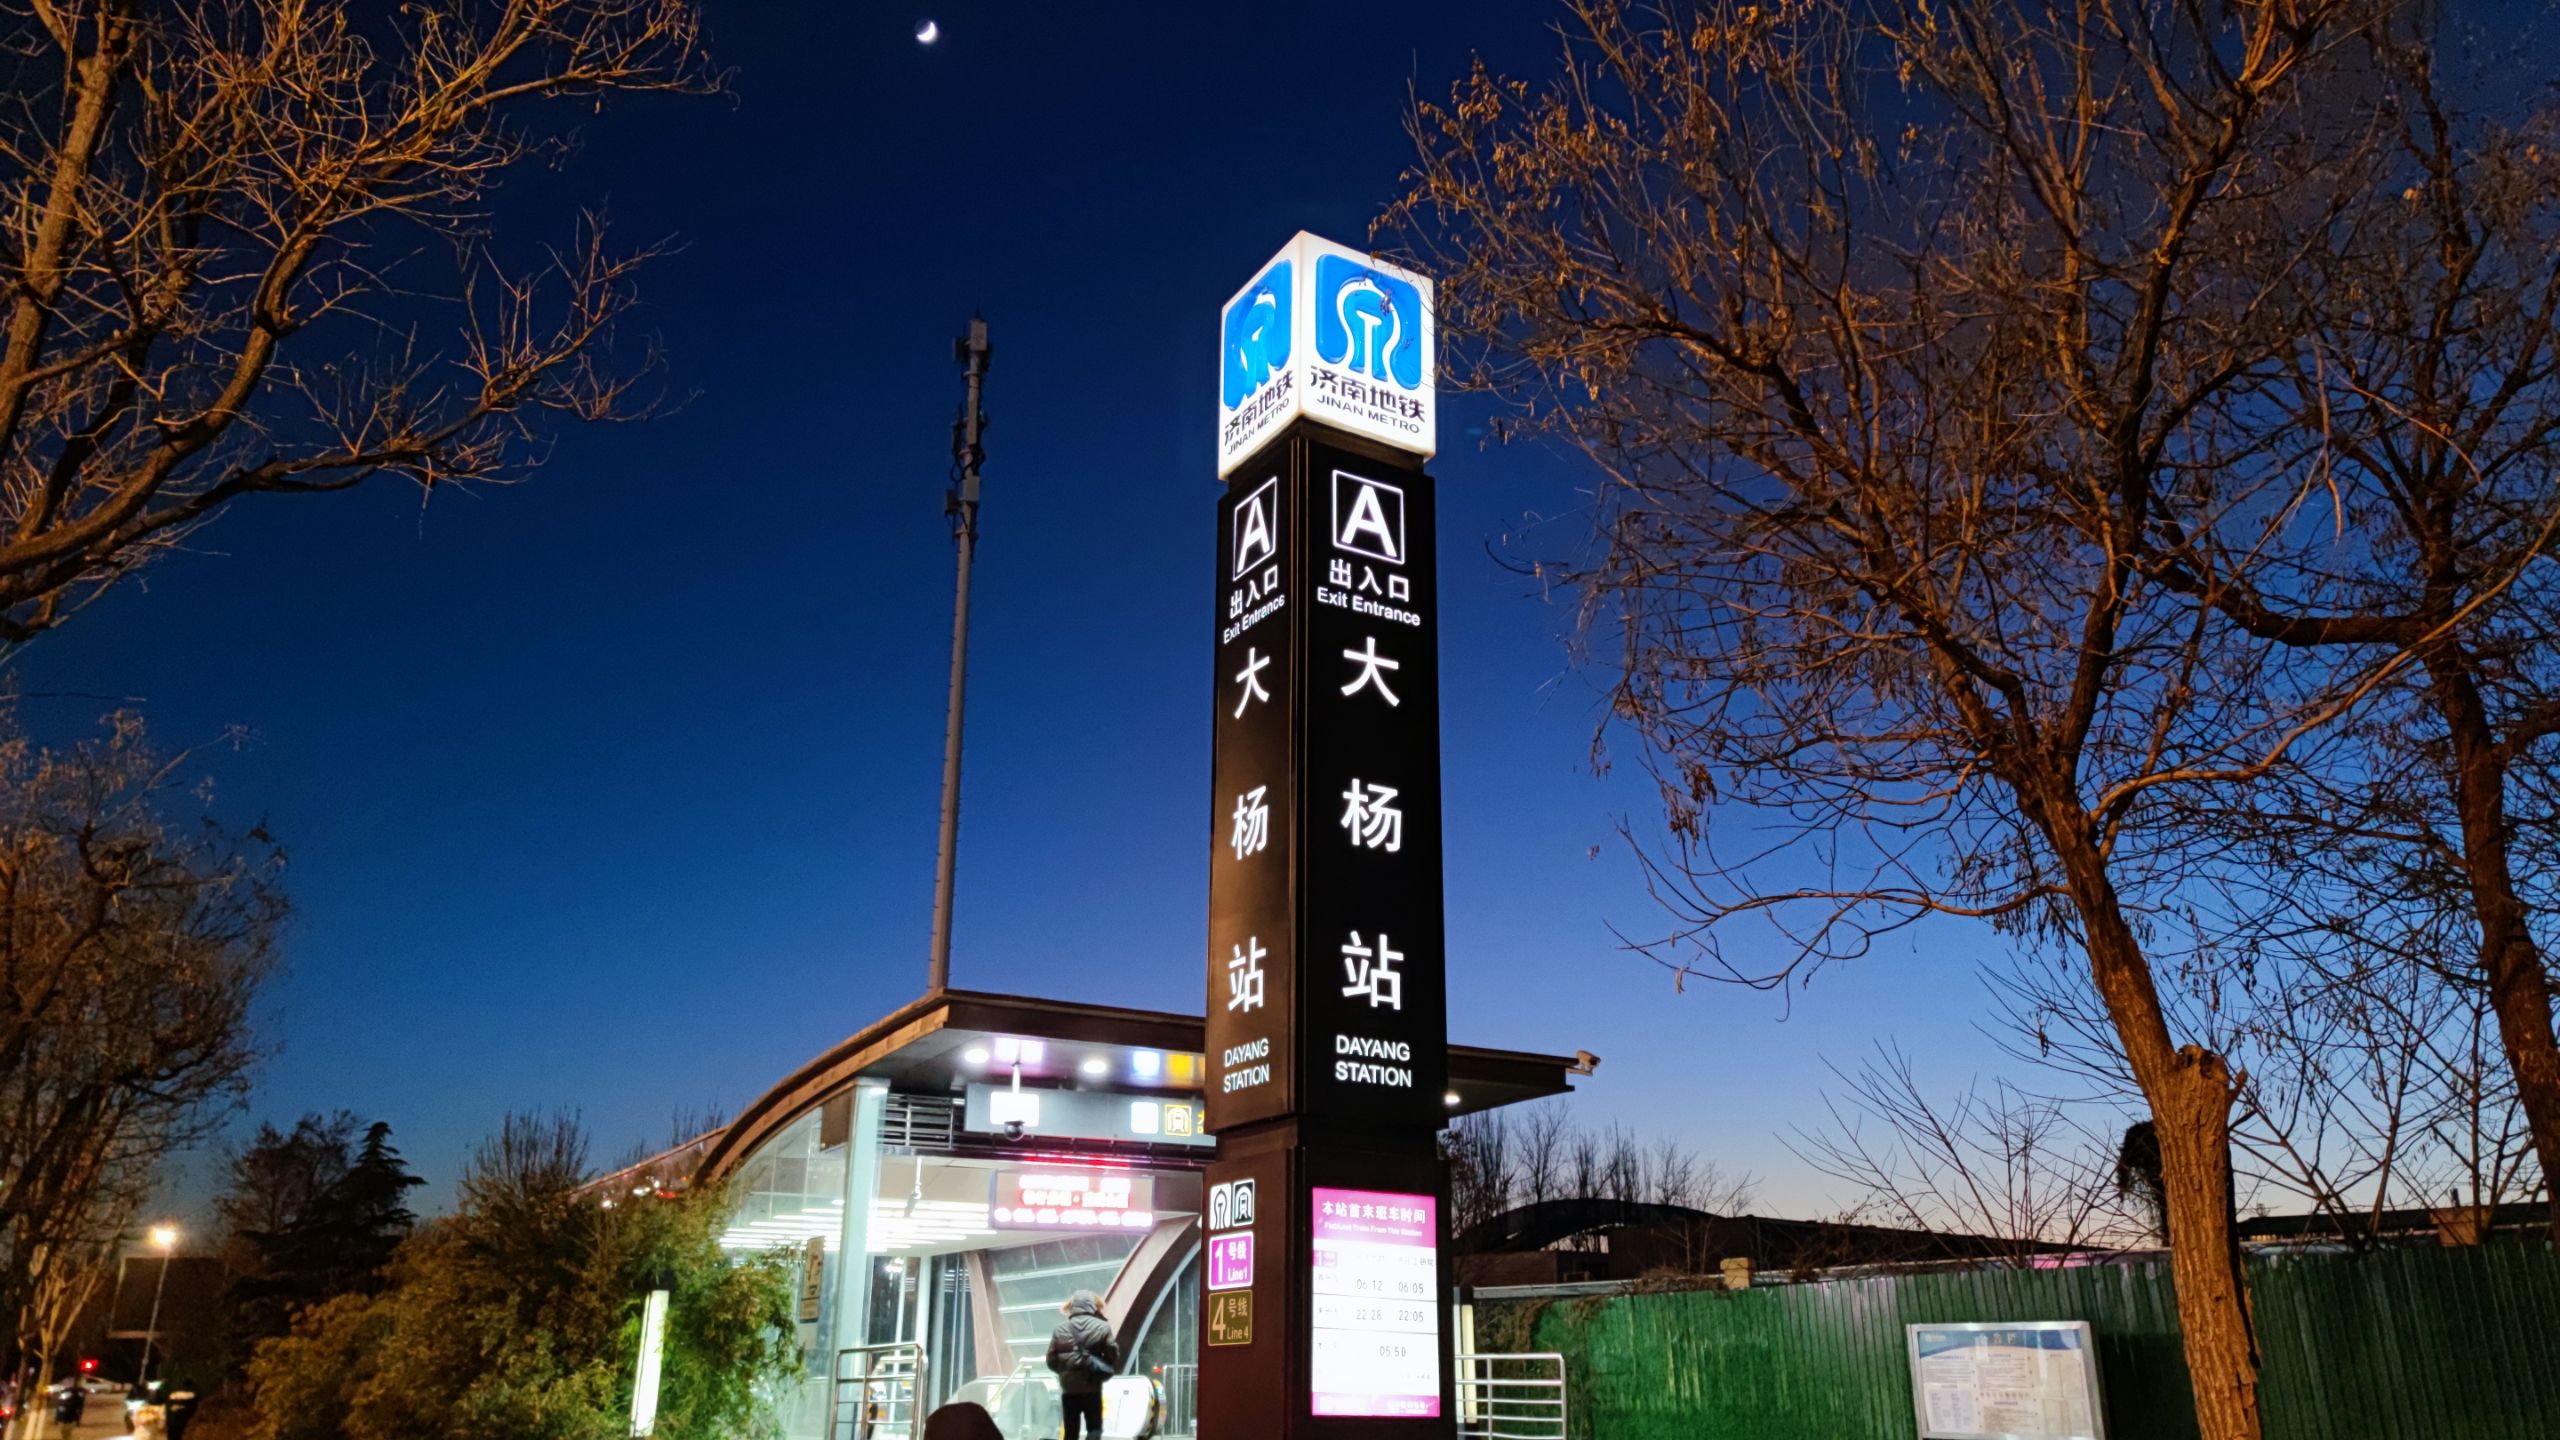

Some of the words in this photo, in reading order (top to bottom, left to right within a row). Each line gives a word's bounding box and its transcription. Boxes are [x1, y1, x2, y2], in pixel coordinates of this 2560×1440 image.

[1224, 369, 1294, 447] 济南地铁
[1310, 364, 1426, 423] 济南地铁
[1316, 394, 1364, 417] JINAN
[1367, 409, 1421, 434] METRO
[1228, 426, 1255, 456] JINAN
[1257, 397, 1290, 431] METRO
[1236, 496, 1271, 574] A
[1341, 484, 1398, 558] A
[1229, 564, 1278, 620] 出入口
[1329, 557, 1410, 603] 出入口
[1223, 621, 1241, 645] Exit
[1242, 594, 1285, 631] Entrance
[1317, 586, 1348, 608] Exit
[1352, 596, 1421, 627] Entrance
[1228, 646, 1270, 1013] 大杨站
[1340, 636, 1404, 1011] 大杨站
[1224, 1037, 1269, 1067] DAYANG
[1335, 1034, 1411, 1061] DAYANG
[1223, 1064, 1270, 1094] STATION
[1335, 1060, 1412, 1087] STATION
[1322, 1200, 1426, 1225] 本站首末班车时间
